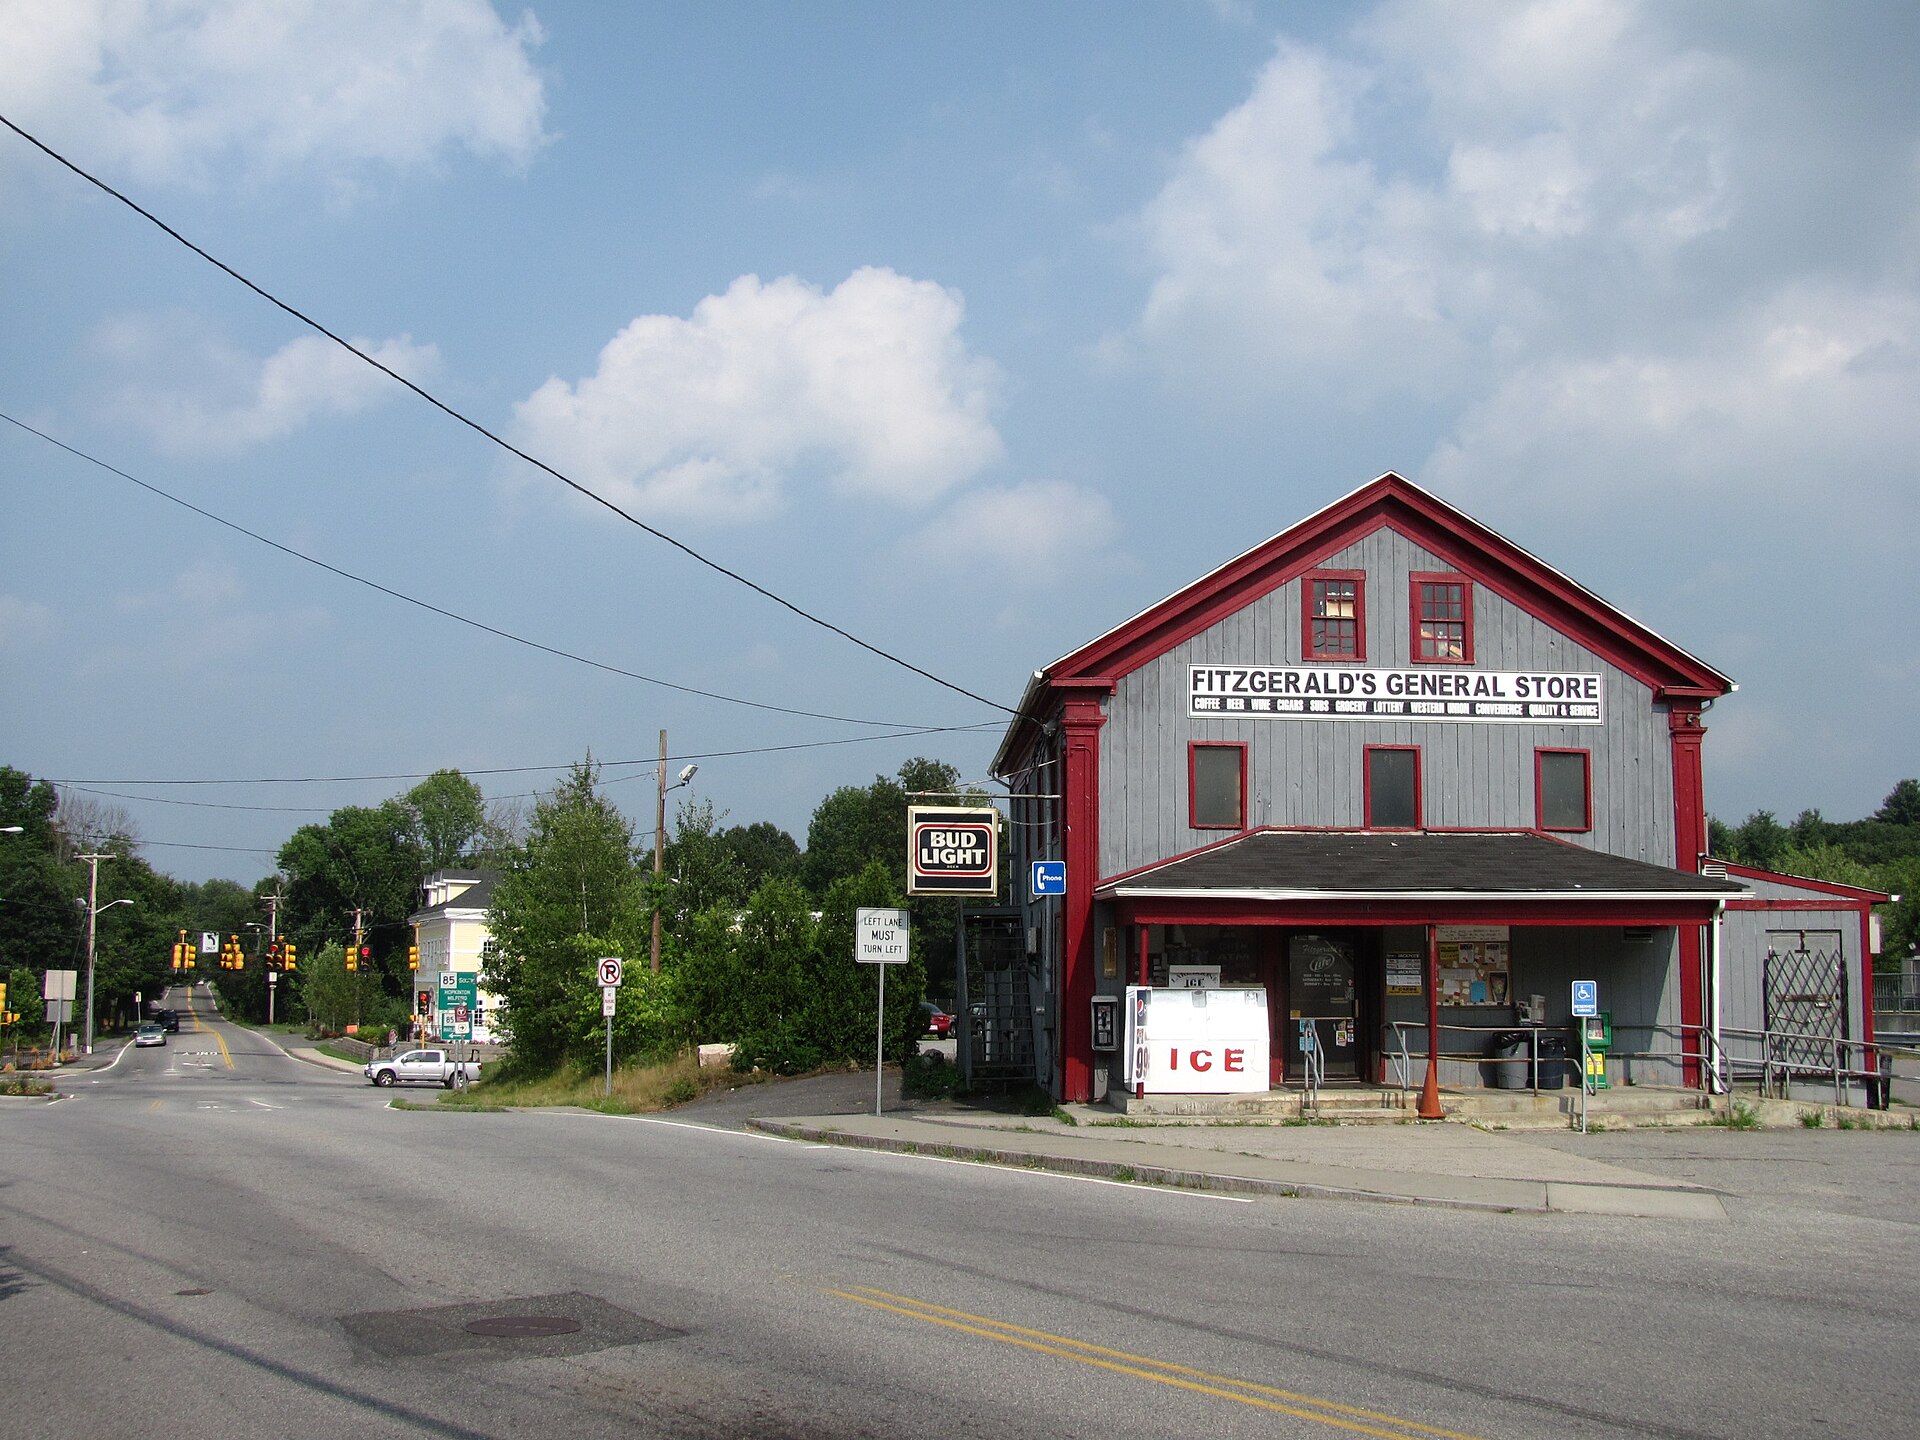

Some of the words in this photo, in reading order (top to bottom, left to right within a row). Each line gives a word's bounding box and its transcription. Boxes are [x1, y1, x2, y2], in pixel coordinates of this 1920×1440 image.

[1192, 669, 1376, 695] FITZGERALD'S
[1386, 673, 1505, 697] GENERAL
[1515, 676, 1598, 699] STORE
[1194, 697, 1220, 710] COFFEE
[1226, 698, 1245, 710] BEER
[1251, 698, 1271, 711] WINE
[1276, 699, 1304, 712] CIGARS
[1309, 699, 1329, 712] SUBS
[1335, 700, 1367, 713] GROCERY
[1373, 701, 1403, 714] LOTTERY
[1410, 702, 1445, 714] WESTERN
[1447, 702, 1470, 715] UNION
[1475, 703, 1523, 716] CONVENIENCE
[1528, 704, 1558, 717] QUALITY
[1560, 704, 1567, 716] &
[1569, 704, 1598, 717] SERVICE
[930, 831, 977, 848] BUD
[921, 848, 986, 864] LIGHT
[864, 917, 881, 926] LEFT
[884, 918, 903, 926] LANE
[871, 930, 895, 941] MUST
[864, 944, 882, 953] TURN
[885, 945, 903, 954] LEFT
[443, 976, 455, 985] 85
[1184, 977, 1206, 988] ICE
[1170, 1047, 1245, 1072] ICE
